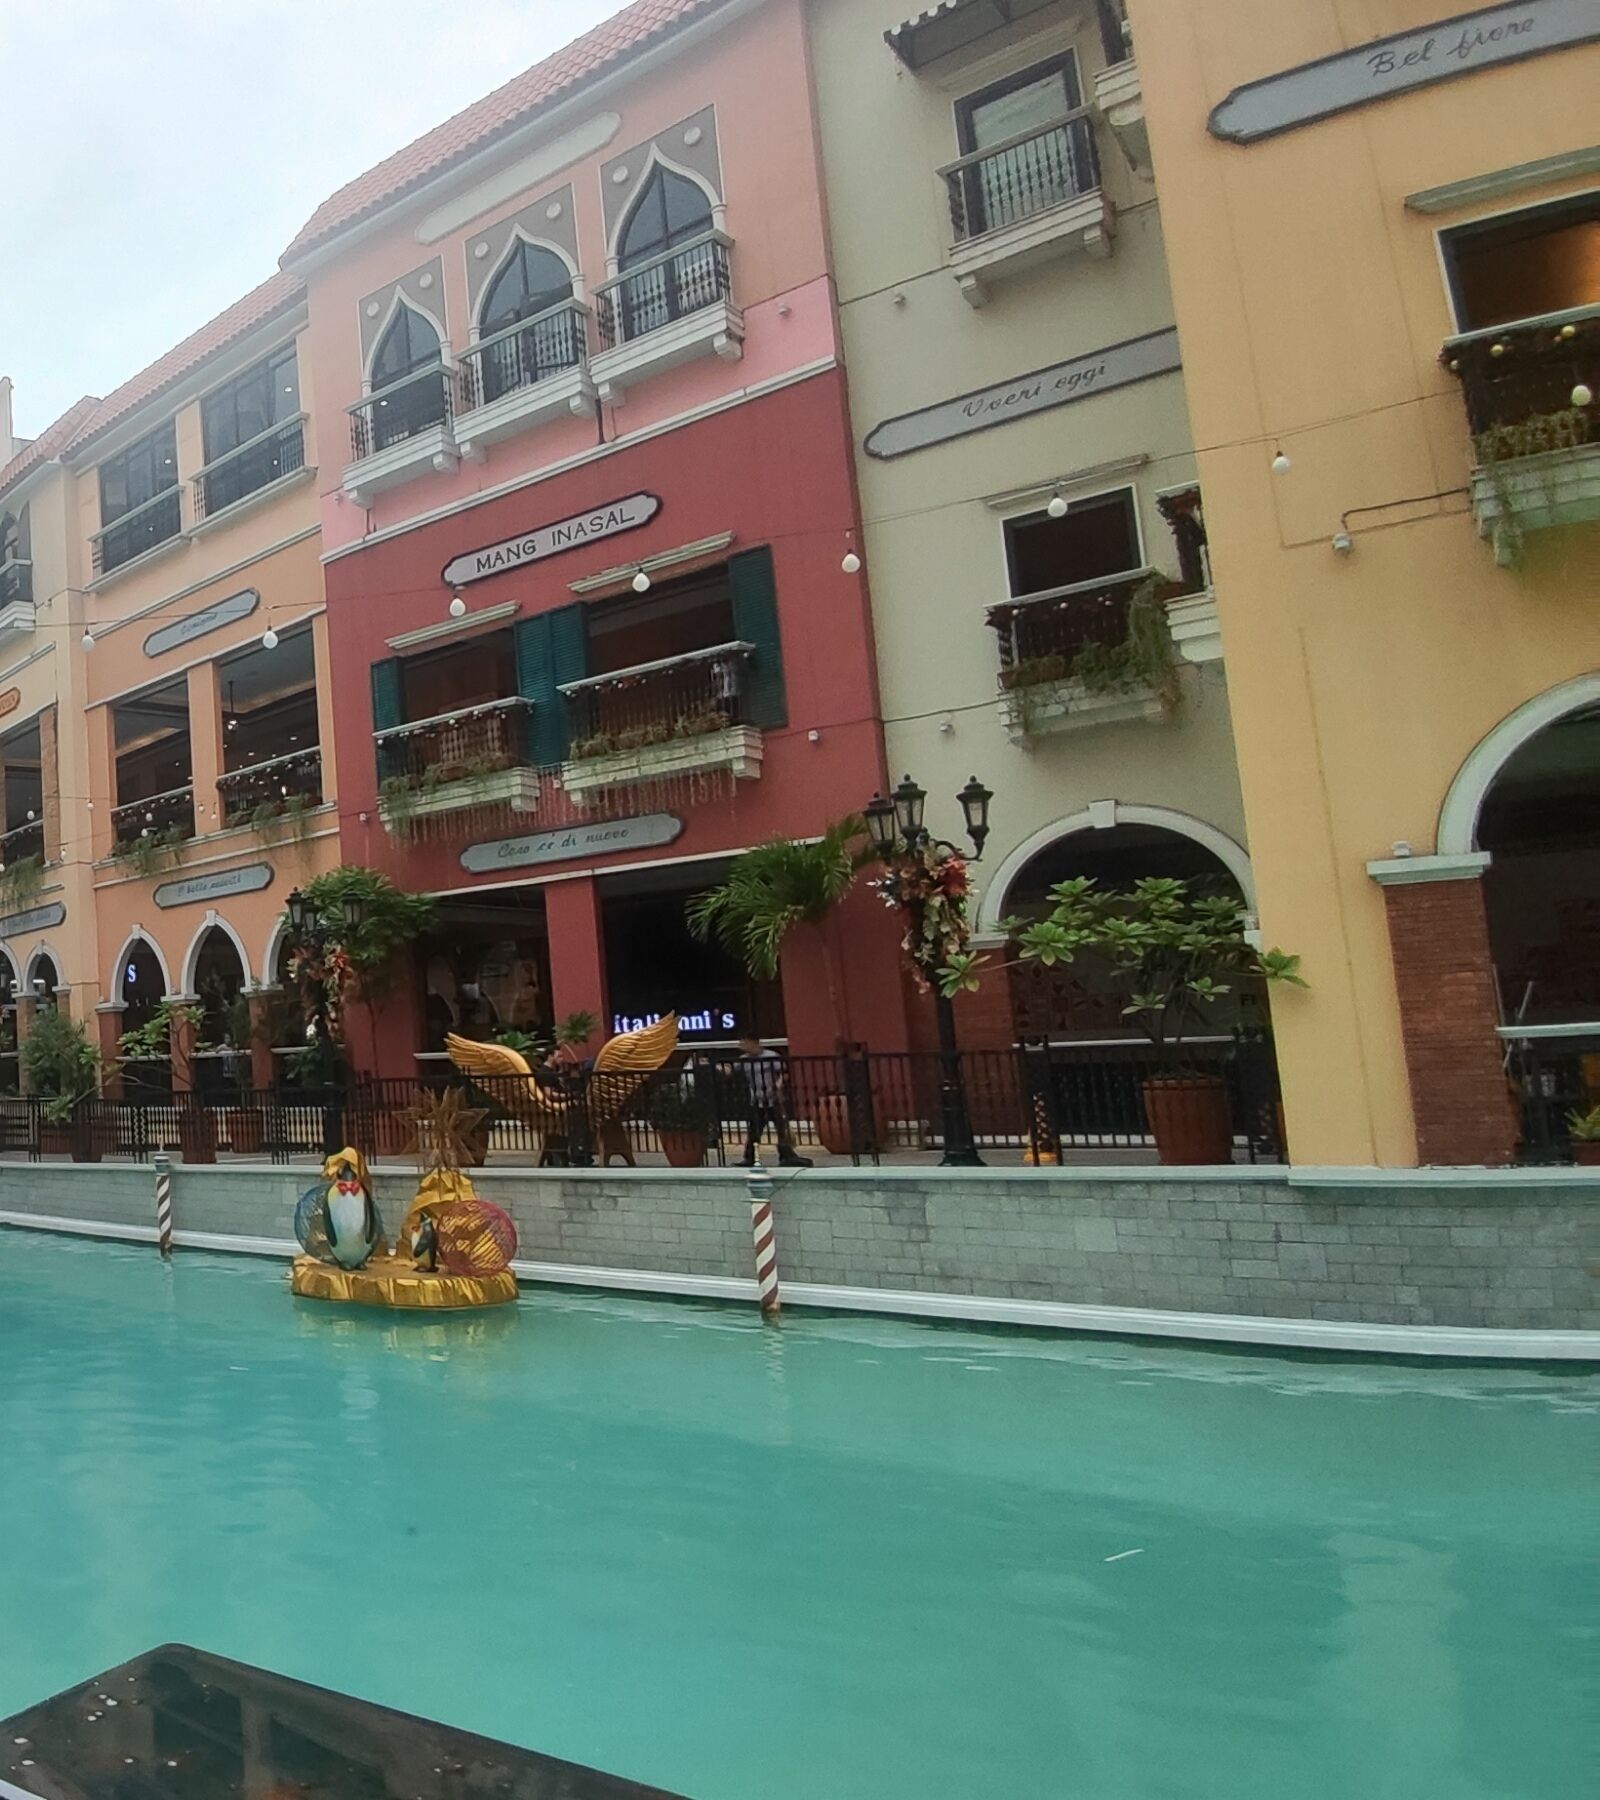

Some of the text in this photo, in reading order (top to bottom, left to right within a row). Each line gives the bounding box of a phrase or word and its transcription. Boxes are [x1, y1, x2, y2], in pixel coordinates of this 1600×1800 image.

[1366, 38, 1436, 77] Bel
[475, 508, 636, 574] MANG INASAL
[613, 1008, 735, 1034] italinni's
